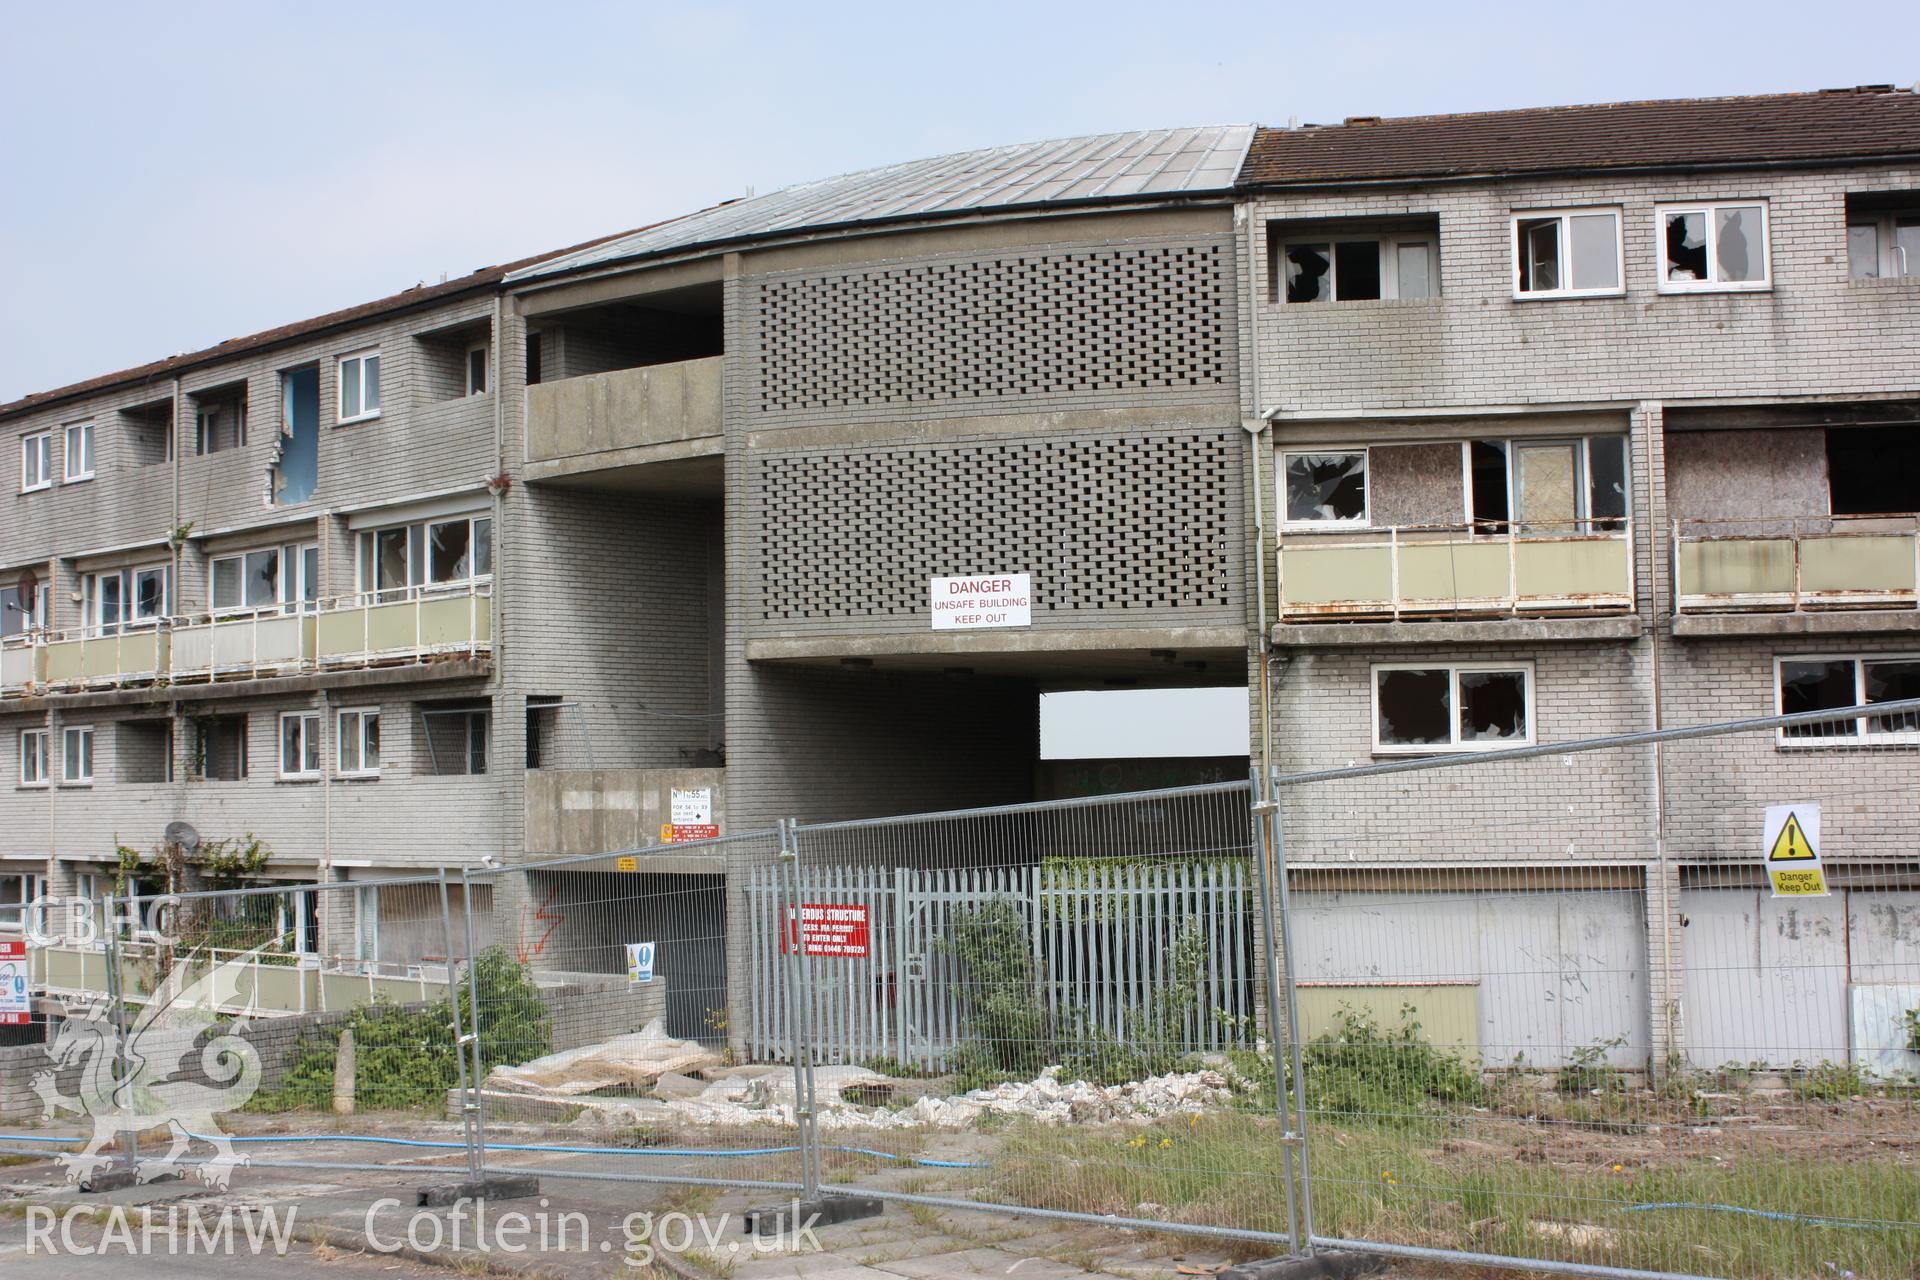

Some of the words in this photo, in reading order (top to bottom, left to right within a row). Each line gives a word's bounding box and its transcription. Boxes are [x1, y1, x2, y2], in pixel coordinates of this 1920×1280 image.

[949, 580, 1011, 594] DANGER
[934, 599, 974, 610] UNSAFE
[979, 597, 1027, 608] BUILDING
[955, 615, 981, 624] KEEP
[986, 613, 1007, 623] OUT
[1780, 872, 1813, 882] Danger
[1777, 883, 1801, 894] Keep
[1803, 882, 1821, 891] Out
[826, 909, 866, 921] STRUCTURE
[832, 925, 854, 933] PERMIT
[811, 934, 831, 942] ENTER
[832, 934, 847, 943] ONLY
[808, 944, 823, 952] RING
